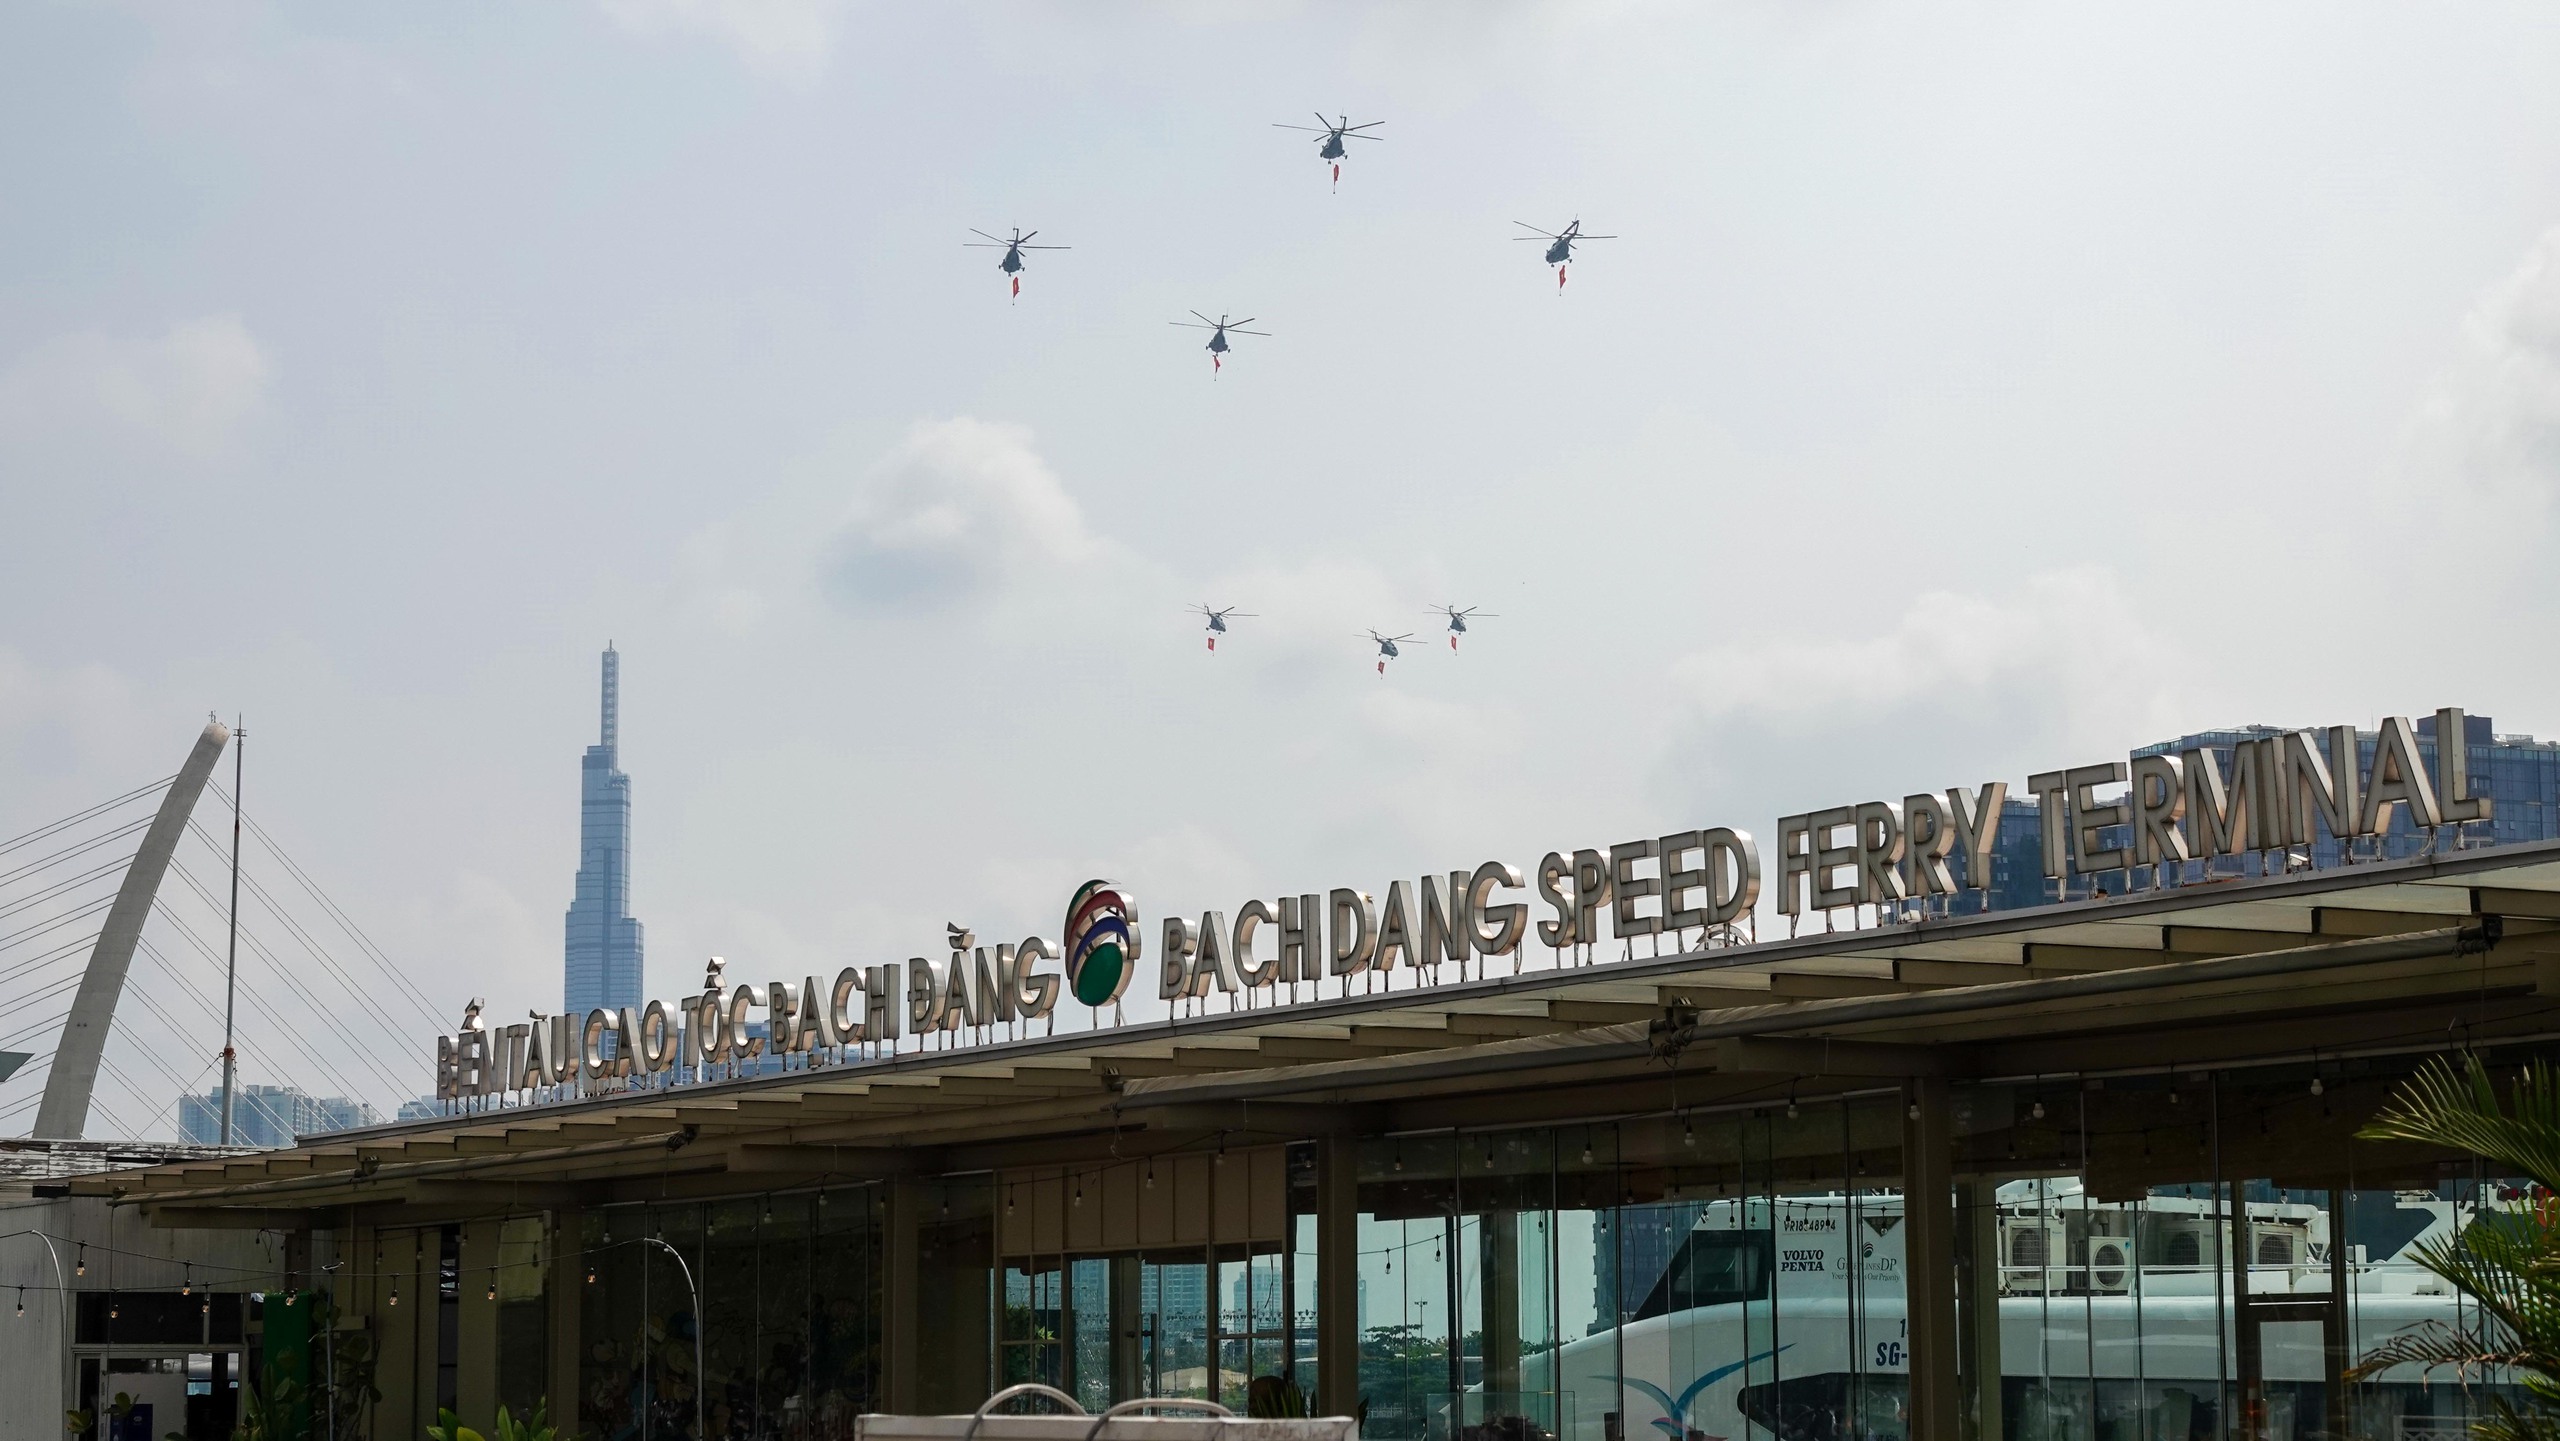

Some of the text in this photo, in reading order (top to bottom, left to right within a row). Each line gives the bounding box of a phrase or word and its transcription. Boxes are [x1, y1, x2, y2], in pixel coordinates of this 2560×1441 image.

[1160, 707, 2492, 1000] BACH DANG SPEED FERRY TERMINAL
[507, 1008, 580, 1090] TÀU
[583, 1000, 678, 1079] CAO
[681, 956, 767, 1067] TỐC
[907, 921, 1061, 1034] ĐẰNG
[1781, 1261, 1824, 1272] PENTA
[1783, 1250, 1824, 1260] VOLVO
